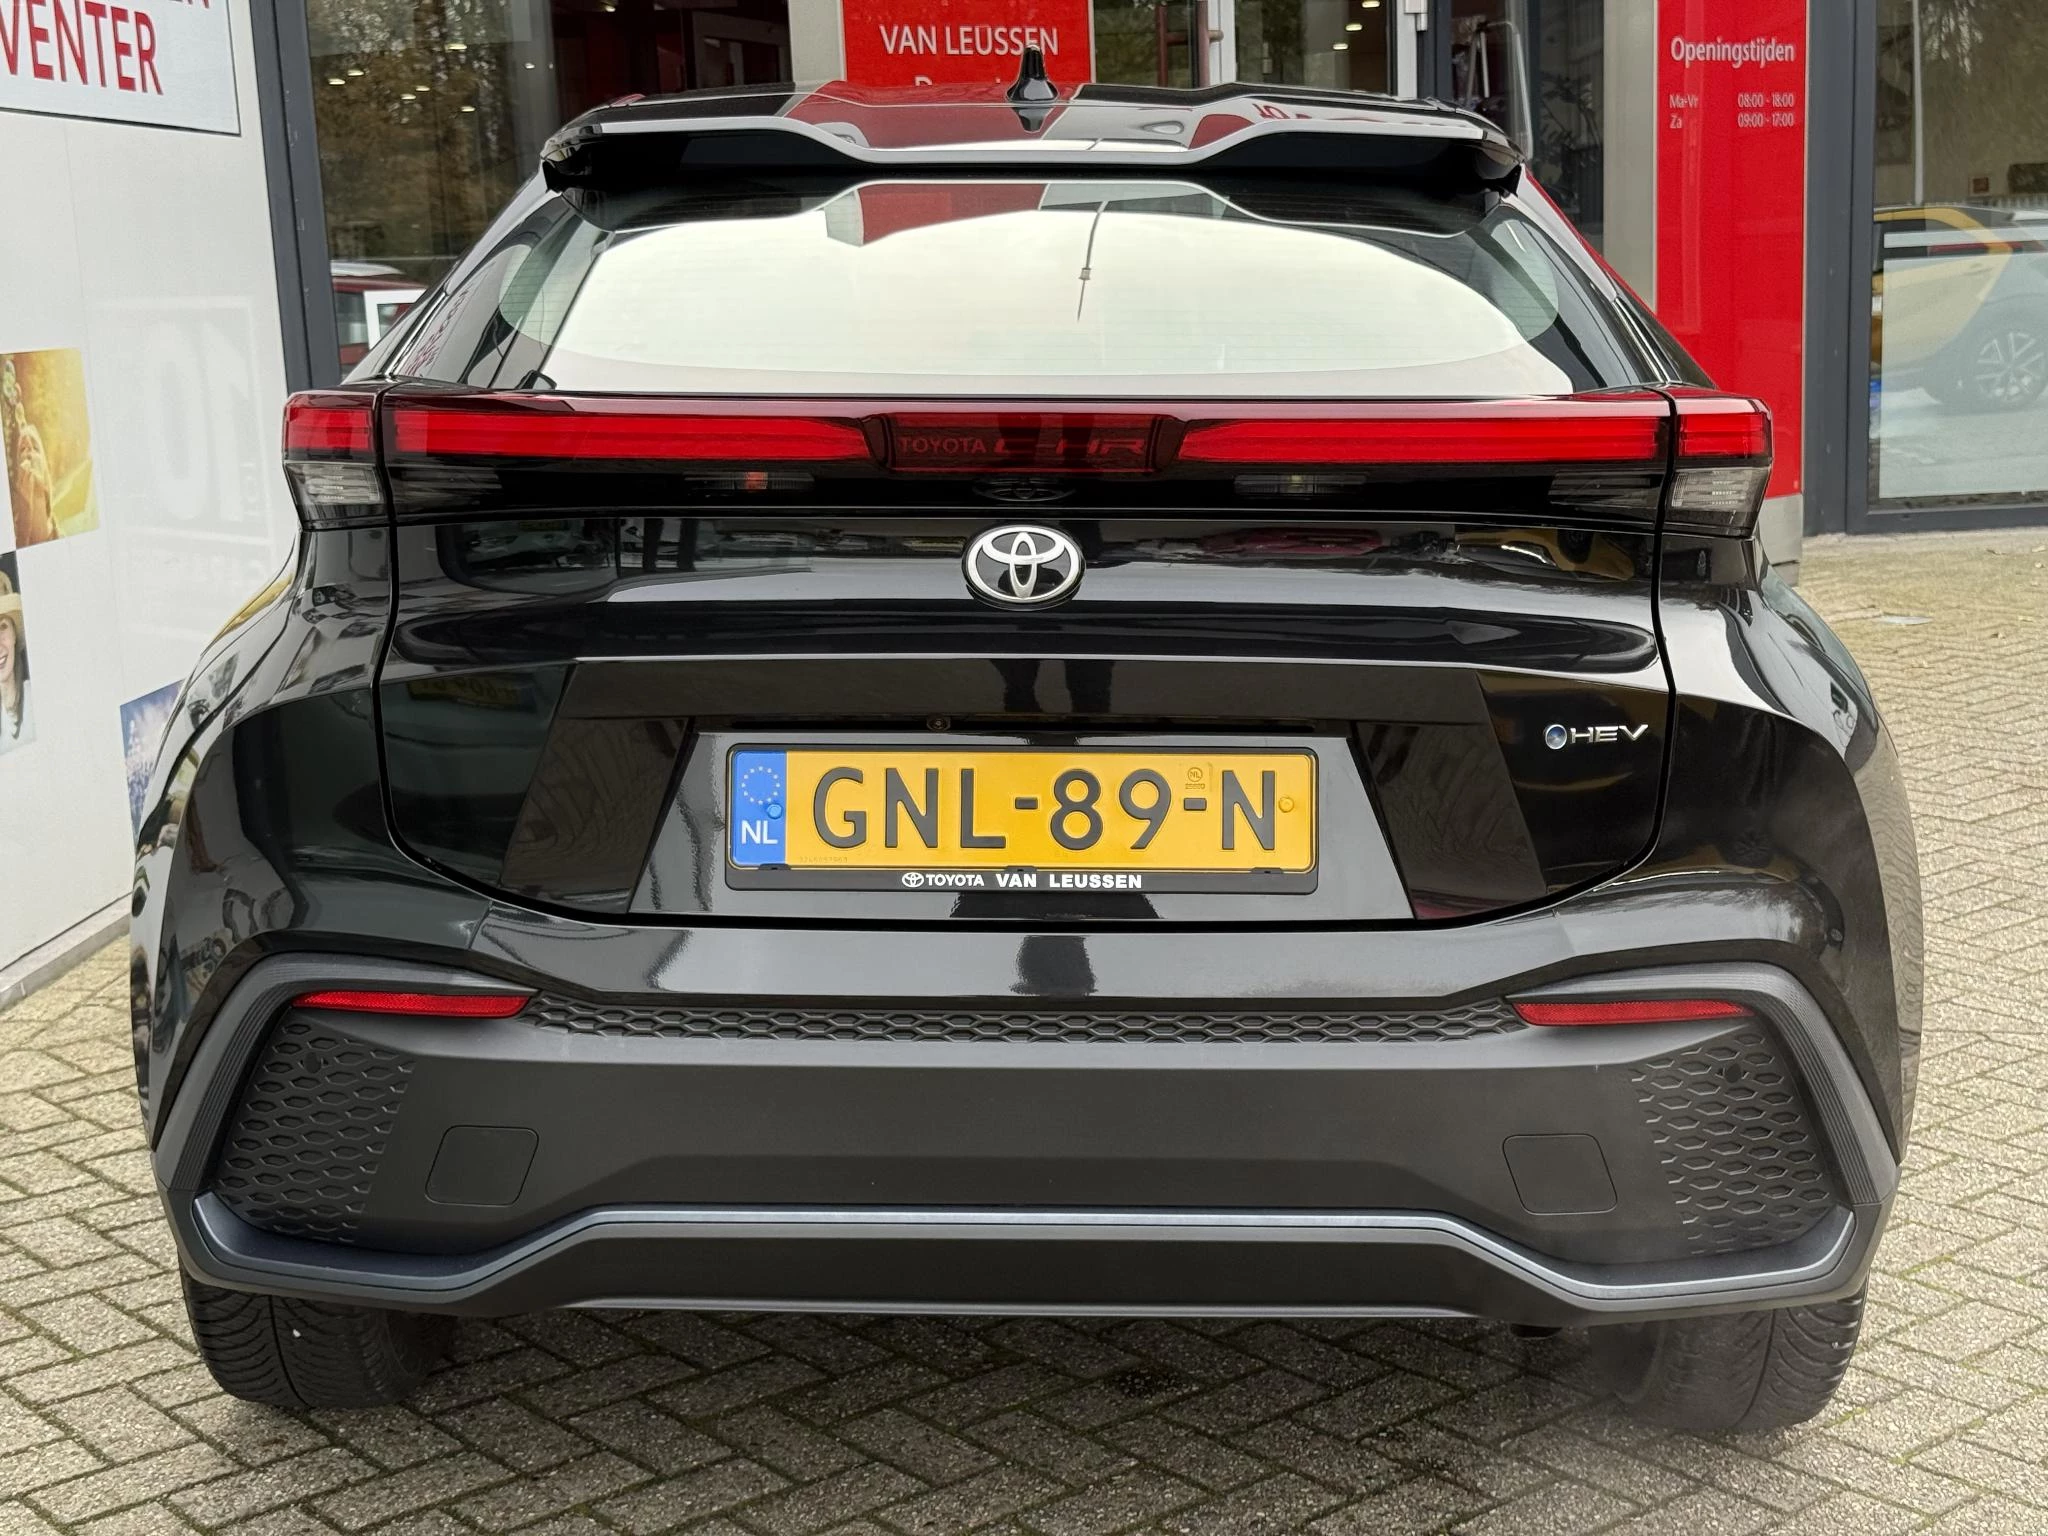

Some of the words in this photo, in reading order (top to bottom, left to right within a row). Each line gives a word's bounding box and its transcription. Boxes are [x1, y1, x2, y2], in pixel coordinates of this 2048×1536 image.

[880, 25, 937, 54] VAN
[946, 26, 1059, 56] LEUSSEN
[1671, 36, 1795, 68] Openingstijden
[1669, 94, 1699, 109] Ma-Vr
[1738, 93, 1764, 108] 08:00
[1772, 93, 1795, 108] 18:00
[1670, 115, 1683, 129] Za
[1738, 113, 1764, 128] 09:00
[1772, 113, 1795, 127] 17:00
[900, 437, 987, 454] TOYOTA
[1570, 724, 1649, 744] HEV
[812, 767, 1276, 851] GNL-89-N
[741, 820, 779, 845] NL
[926, 874, 985, 887] TOYOTA
[996, 873, 1037, 888] VAN
[1049, 874, 1142, 889] LEUSSEN
